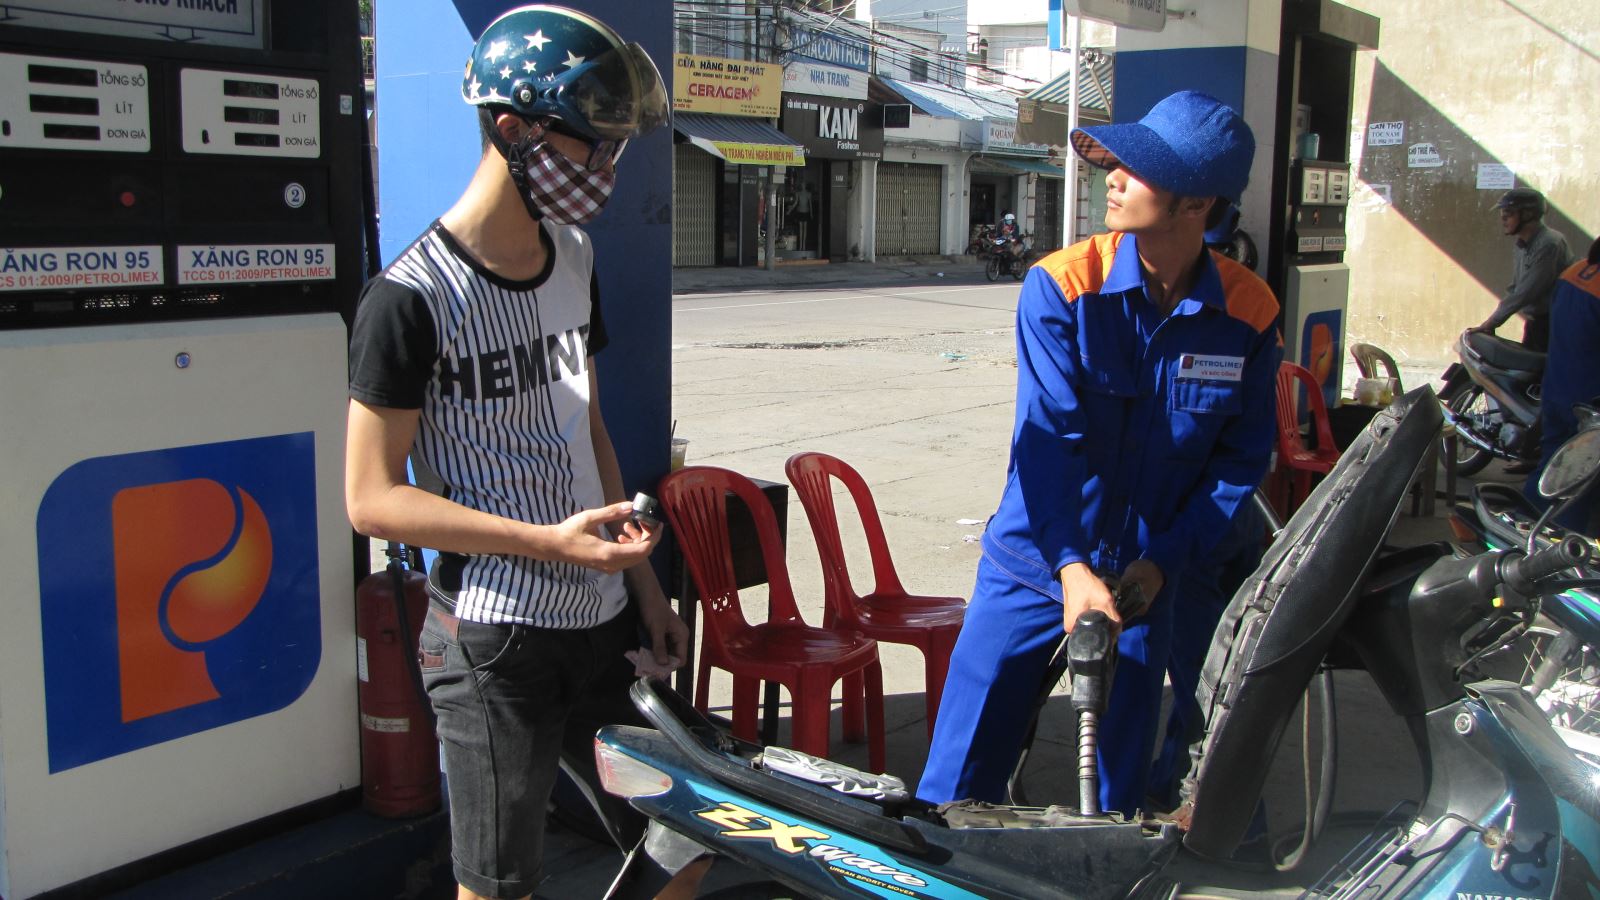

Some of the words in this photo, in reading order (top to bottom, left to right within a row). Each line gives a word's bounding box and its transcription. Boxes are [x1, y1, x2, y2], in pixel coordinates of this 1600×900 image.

[100, 70, 129, 86] TỔNG
[131, 73, 146, 87] SỐ
[810, 69, 825, 84] NHA
[827, 71, 850, 88] TRANG
[281, 84, 304, 98] TỔNG
[306, 86, 318, 100] SỐ
[688, 83, 752, 101] CERAGEM
[818, 105, 859, 141] KAM
[107, 129, 129, 139] ĐƠN
[836, 140, 860, 151] Fashion
[291, 189, 300, 203] 2
[0, 248, 58, 273] ĂNG
[66, 252, 118, 272] RON
[125, 251, 150, 270] 95
[191, 246, 250, 268] XĂNG
[257, 249, 298, 266] RON
[304, 248, 325, 265] 95
[19, 271, 159, 288] 01:2009/PETROLIMEX
[183, 269, 216, 282] TCCS
[218, 266, 332, 281] 01:2009/PETROLIMEX
[829, 866, 855, 879] URBAN
[855, 873, 885, 889] SPORTY
[886, 883, 915, 897] MOVER
